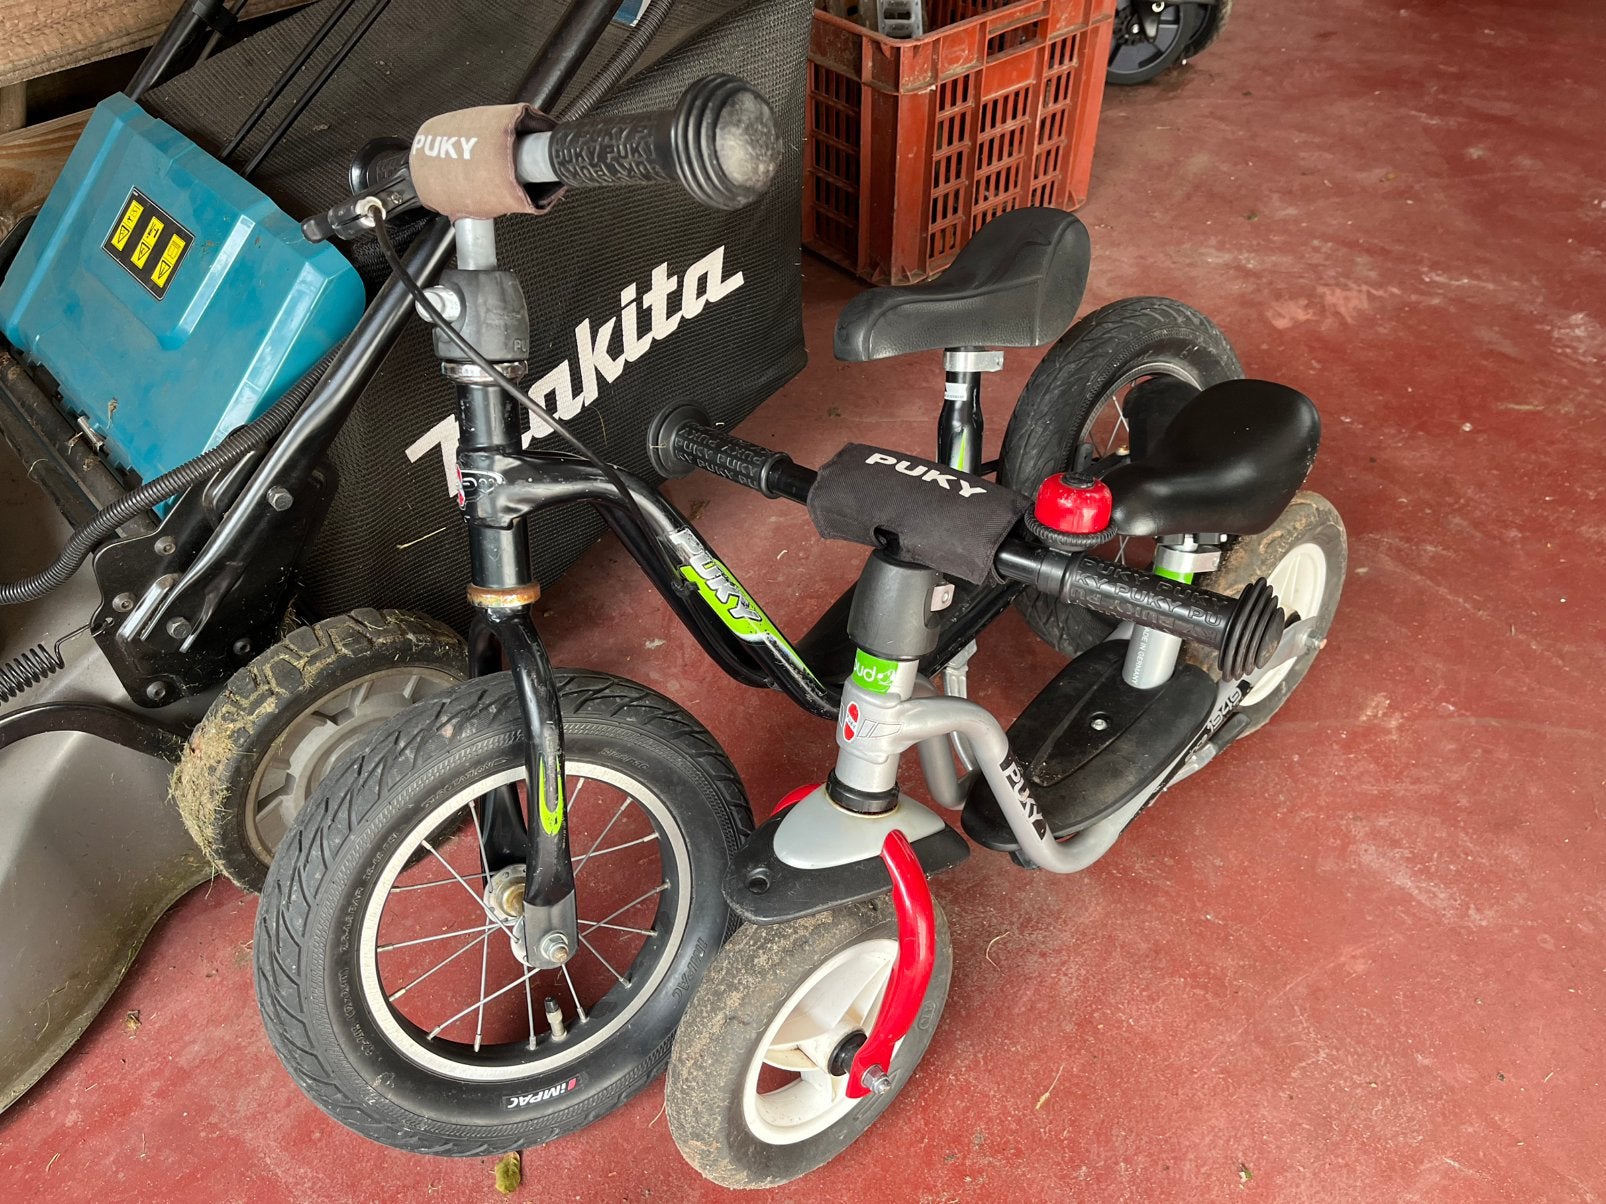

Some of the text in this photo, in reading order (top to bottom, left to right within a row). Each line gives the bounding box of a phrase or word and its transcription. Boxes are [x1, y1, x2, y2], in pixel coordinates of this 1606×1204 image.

[413, 134, 478, 160] PUKY
[865, 453, 988, 498] PUKY
[669, 528, 762, 622] PUKY
[1114, 582, 1181, 613] PUKY
[1138, 642, 1146, 650] IN
[1131, 651, 1144, 684] GERMANY
